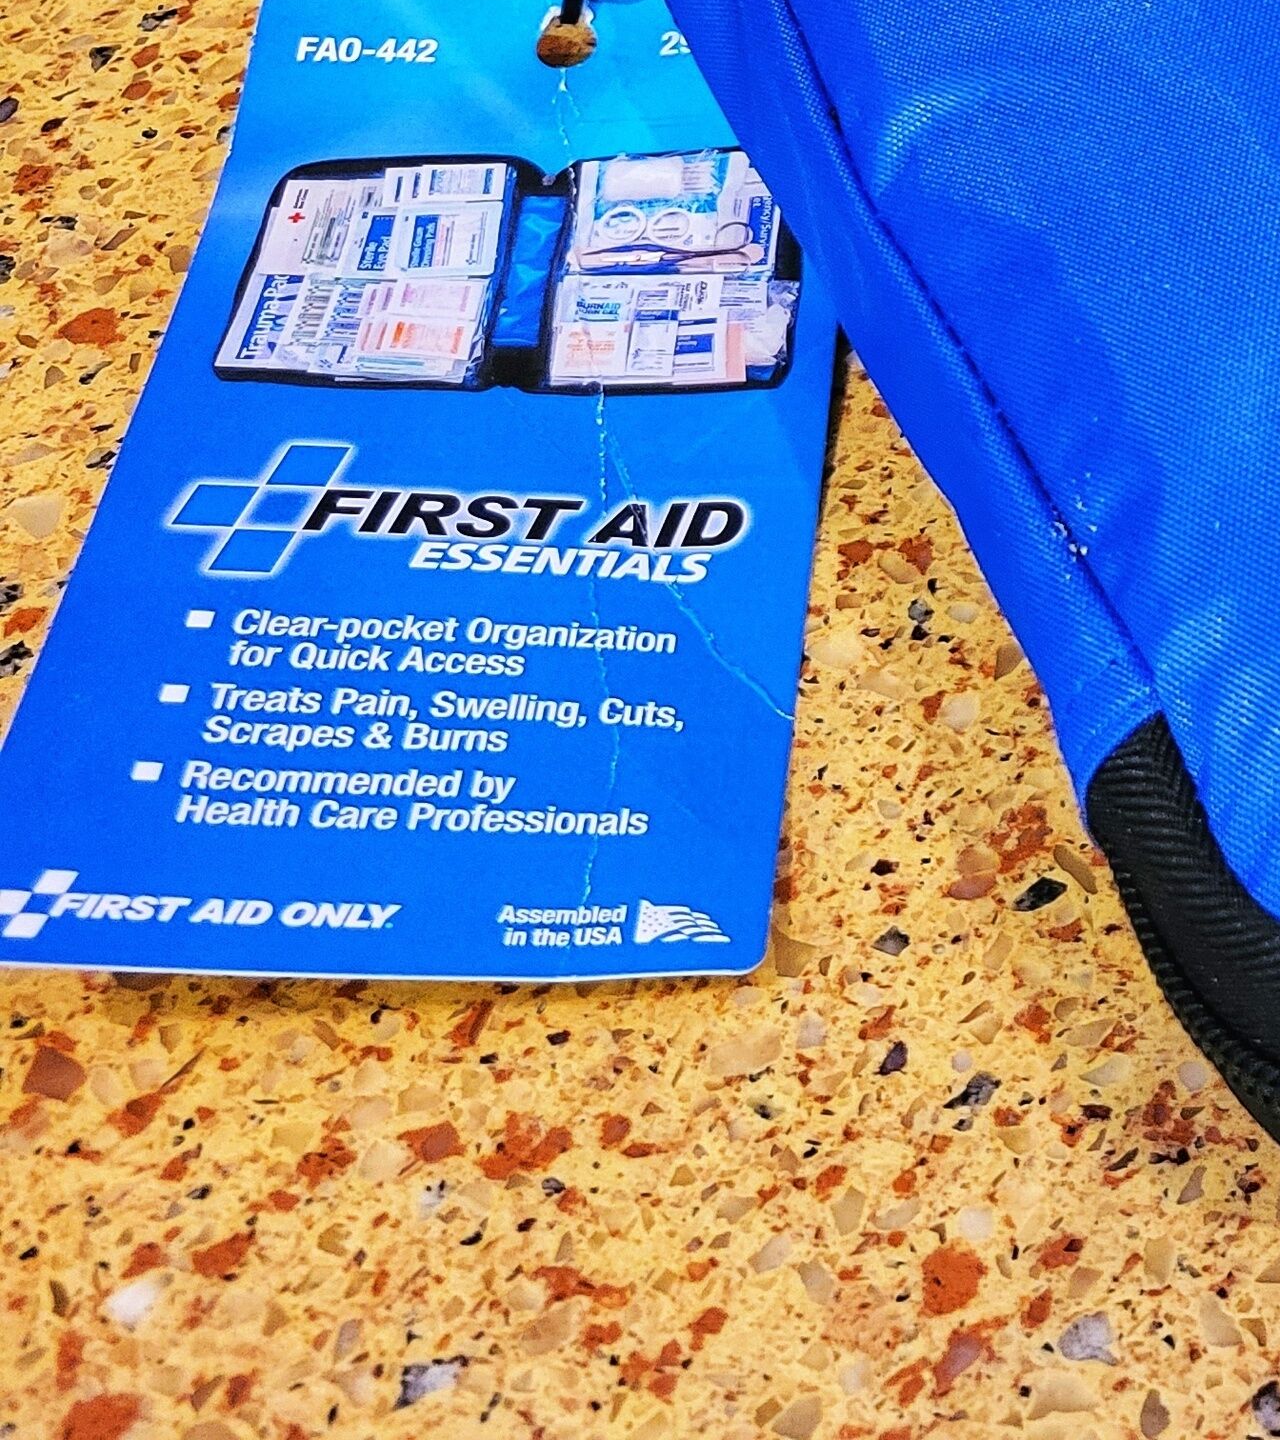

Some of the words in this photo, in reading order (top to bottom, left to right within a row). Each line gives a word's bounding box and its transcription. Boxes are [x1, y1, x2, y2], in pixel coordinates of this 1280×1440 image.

[297, 36, 438, 63] FAO-442
[240, 298, 280, 359] Trauma
[301, 489, 584, 541] FIRST
[588, 501, 745, 549] AID
[408, 540, 713, 585] ESSENTIALS
[233, 609, 460, 644] Clear-pocket
[467, 617, 677, 653] Organization
[230, 641, 285, 667] for
[290, 642, 393, 671] Quick
[397, 646, 525, 675] Access
[212, 683, 323, 714] Treats
[332, 688, 418, 721] Pain,
[431, 691, 587, 728] Swelling,
[599, 697, 684, 732] Cuts,
[203, 715, 355, 752] Scrapes
[363, 722, 393, 749] &
[403, 722, 509, 752] Burns
[181, 760, 463, 798] Recommended
[471, 771, 517, 804] by
[176, 795, 300, 827] Health
[310, 800, 398, 830] Care
[408, 803, 649, 836] Professionals
[50, 893, 192, 923] FIRST
[189, 898, 274, 925] AID
[497, 905, 628, 926] Assembled
[503, 928, 527, 946] in
[532, 928, 572, 947] the
[574, 926, 623, 945] USA
